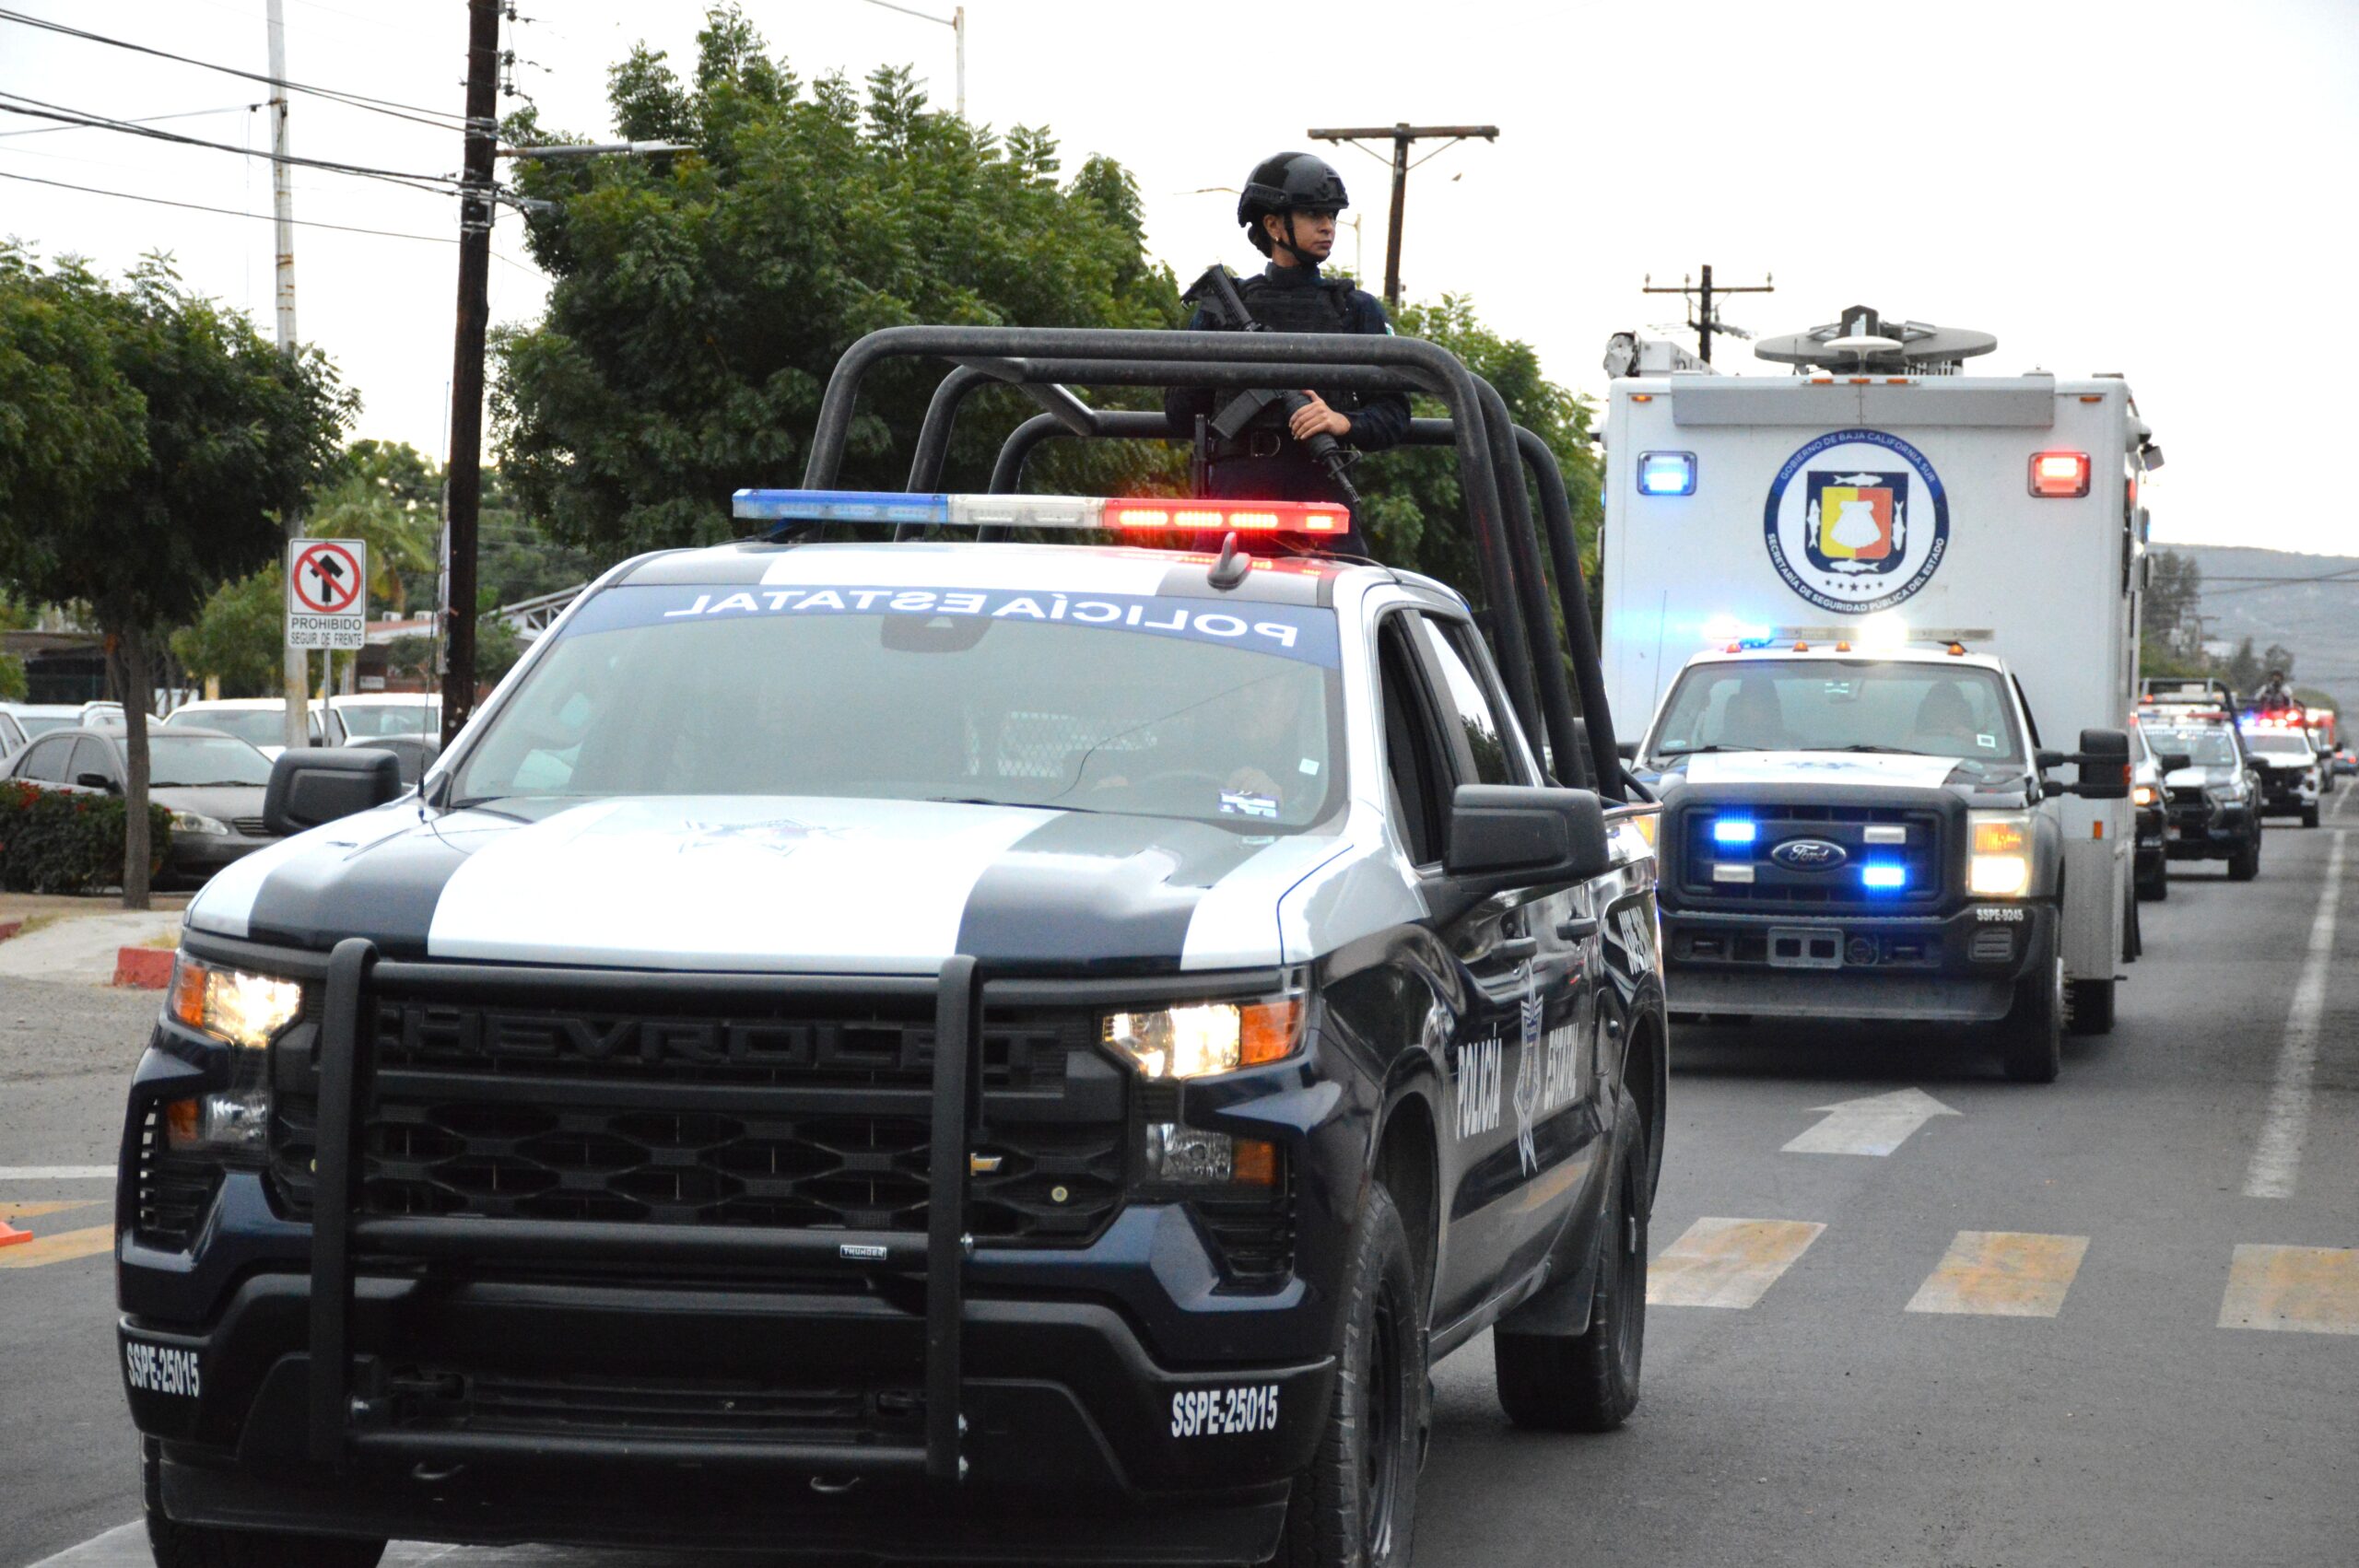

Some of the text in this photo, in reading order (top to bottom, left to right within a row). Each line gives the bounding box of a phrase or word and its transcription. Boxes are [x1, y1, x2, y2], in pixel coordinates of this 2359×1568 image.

[1780, 432, 1936, 483] GOBIERNO DE BAJA CALIFORNIA SUR
[1767, 532, 1800, 588] SECRETARÍA
[1800, 585, 1812, 599] DE
[1812, 592, 1868, 613] SEGURIDAD
[1908, 574, 1927, 592] DEL
[1924, 537, 1945, 578] ESTADO
[290, 632, 362, 646] SEGUIR DE FRENTE
[291, 617, 362, 630] PROHIBIDO
[1789, 844, 1829, 861] Ford
[1456, 1022, 1579, 1141] POLICÍA ESTATAL
[843, 1246, 884, 1258] THUNDER
[126, 1341, 199, 1398] SSPE-25015
[1171, 1385, 1278, 1437] SSPE-25015
